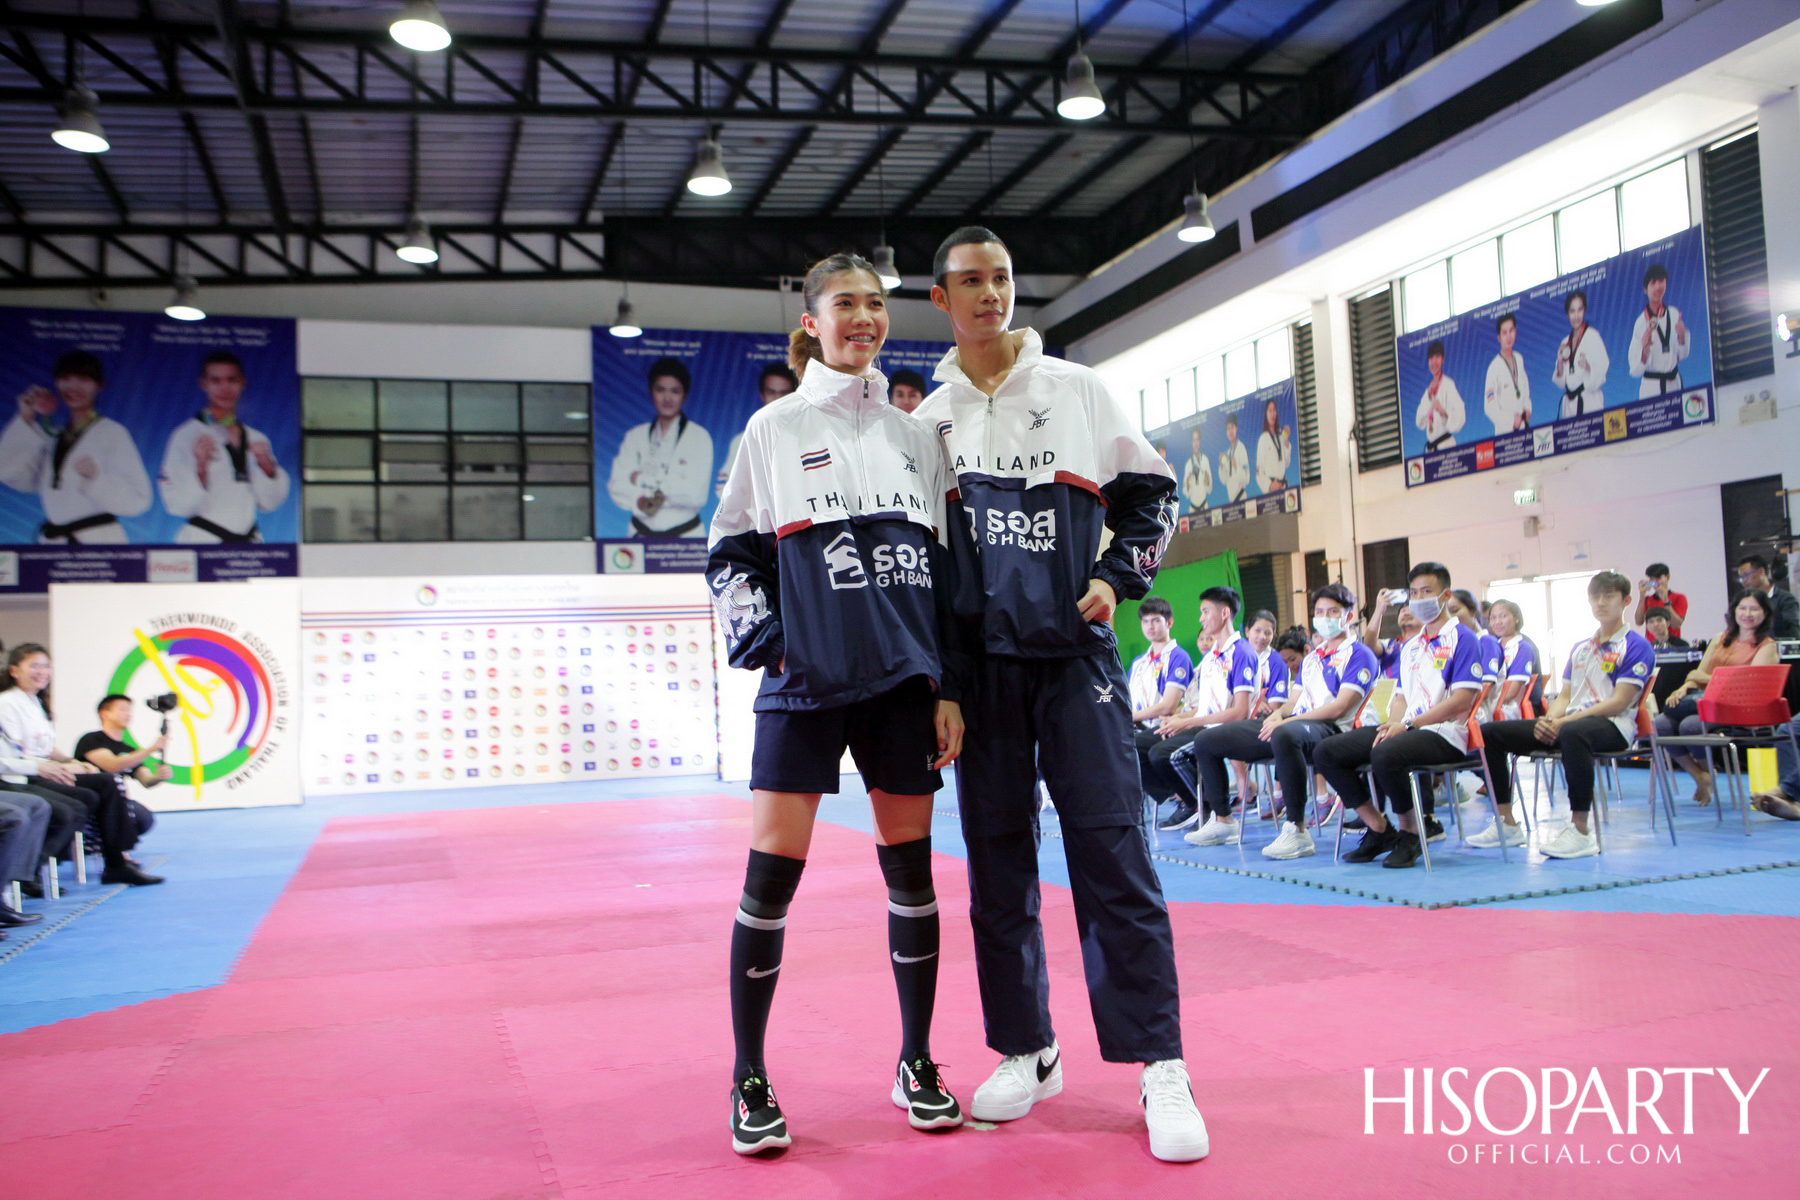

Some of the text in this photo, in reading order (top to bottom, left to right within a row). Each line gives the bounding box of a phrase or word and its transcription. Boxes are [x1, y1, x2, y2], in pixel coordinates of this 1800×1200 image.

[1028, 417, 1051, 430] FBT
[903, 463, 919, 474] FB
[949, 450, 1056, 471] AILAND
[150, 611, 238, 633] TAEKWONDO
[241, 631, 290, 707] ASSOCIATION
[1096, 694, 1114, 703] FBT
[274, 716, 289, 734] OF
[225, 741, 280, 791] THAILAND
